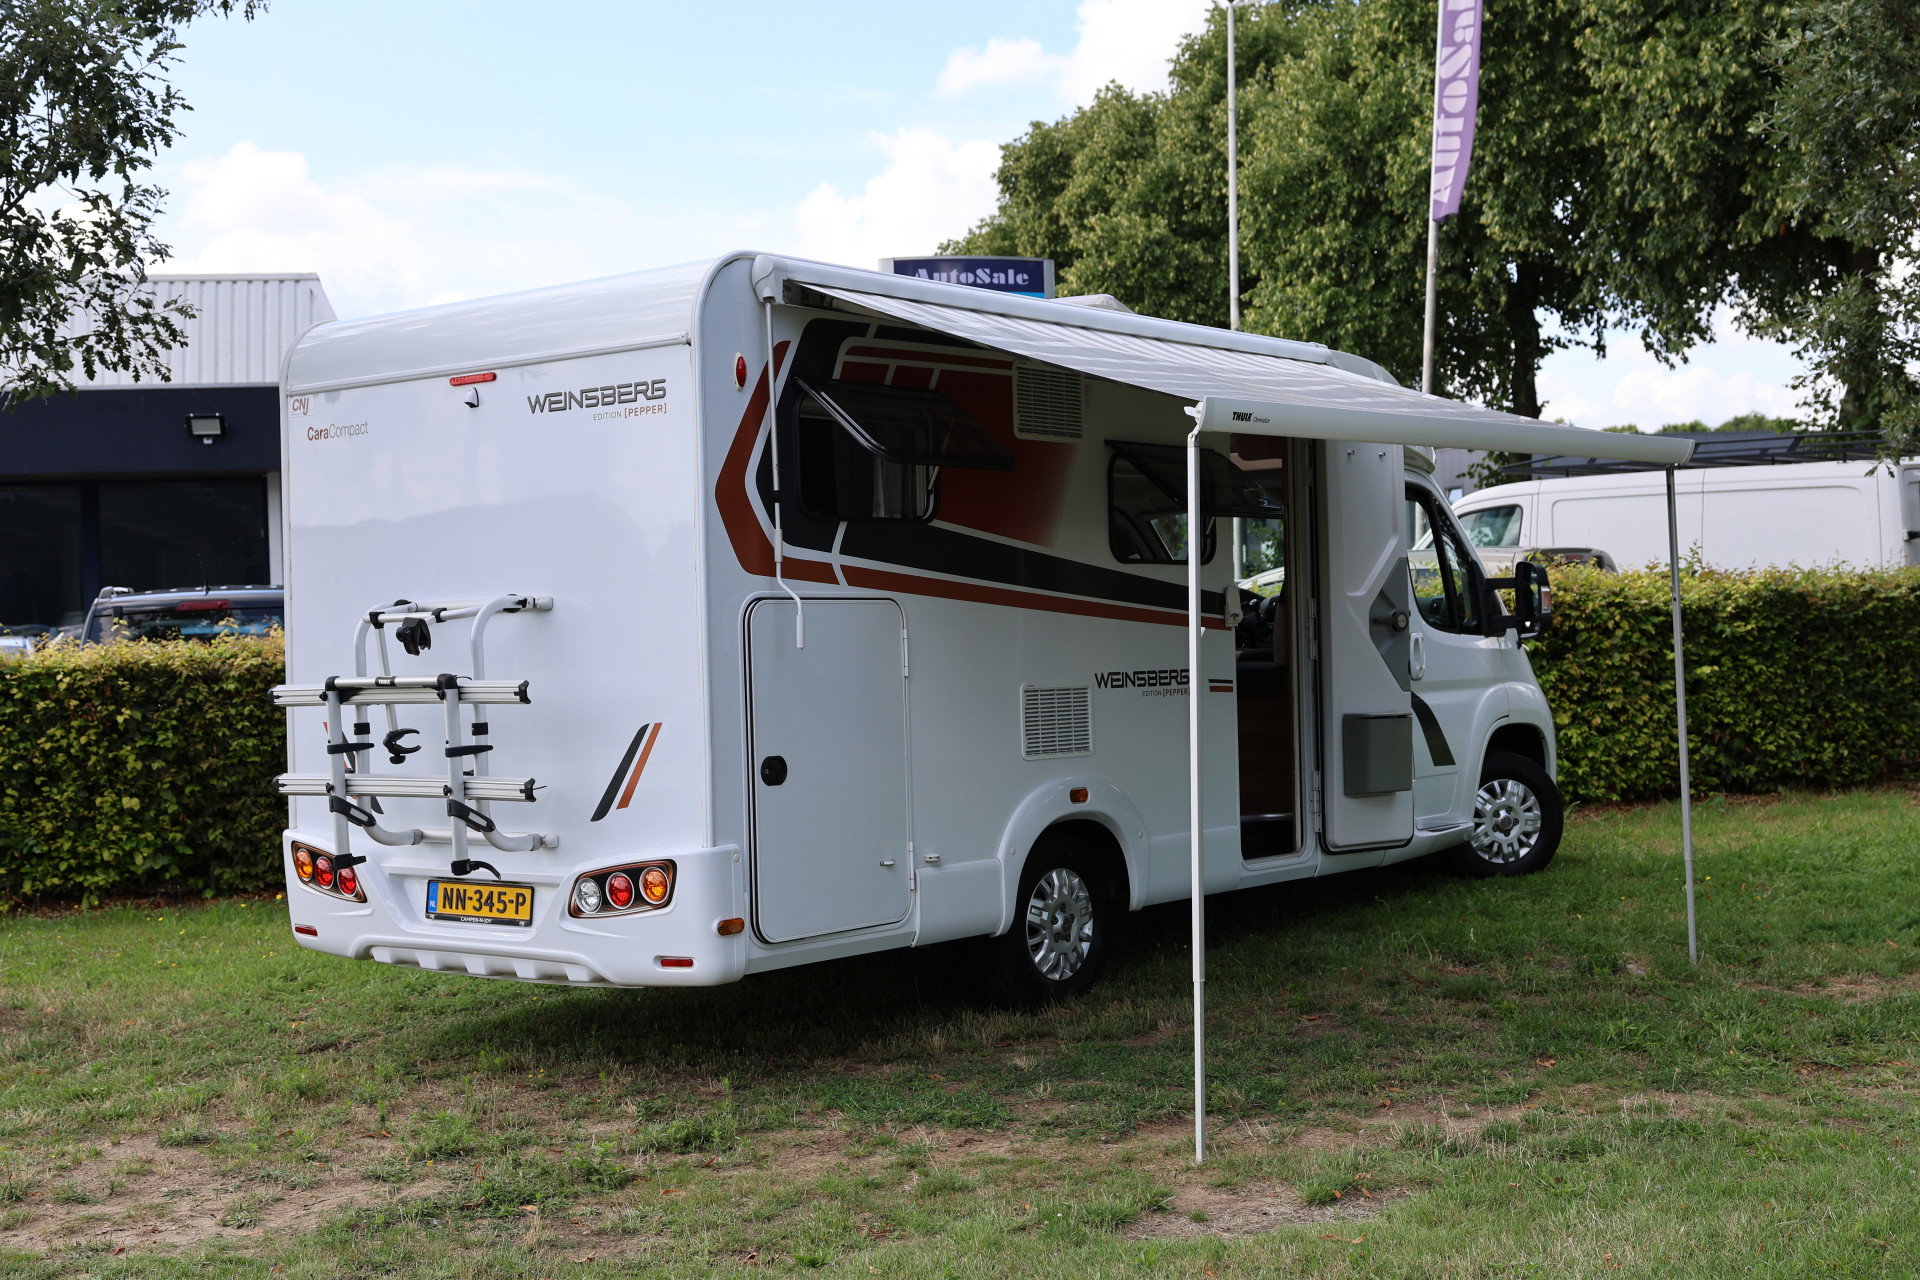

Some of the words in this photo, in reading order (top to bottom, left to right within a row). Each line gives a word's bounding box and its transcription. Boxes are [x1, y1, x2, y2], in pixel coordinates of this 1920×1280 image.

[914, 268, 1029, 285] AutoSale
[527, 378, 667, 414] WEINSBERG
[292, 397, 310, 416] CNJ
[593, 411, 622, 421] EDITION
[1232, 411, 1253, 422] THULE
[307, 420, 369, 441] CaraCompact
[1094, 668, 1190, 689] WEINSBERG
[429, 900, 437, 908] NL
[442, 887, 527, 915] NN-345-P
